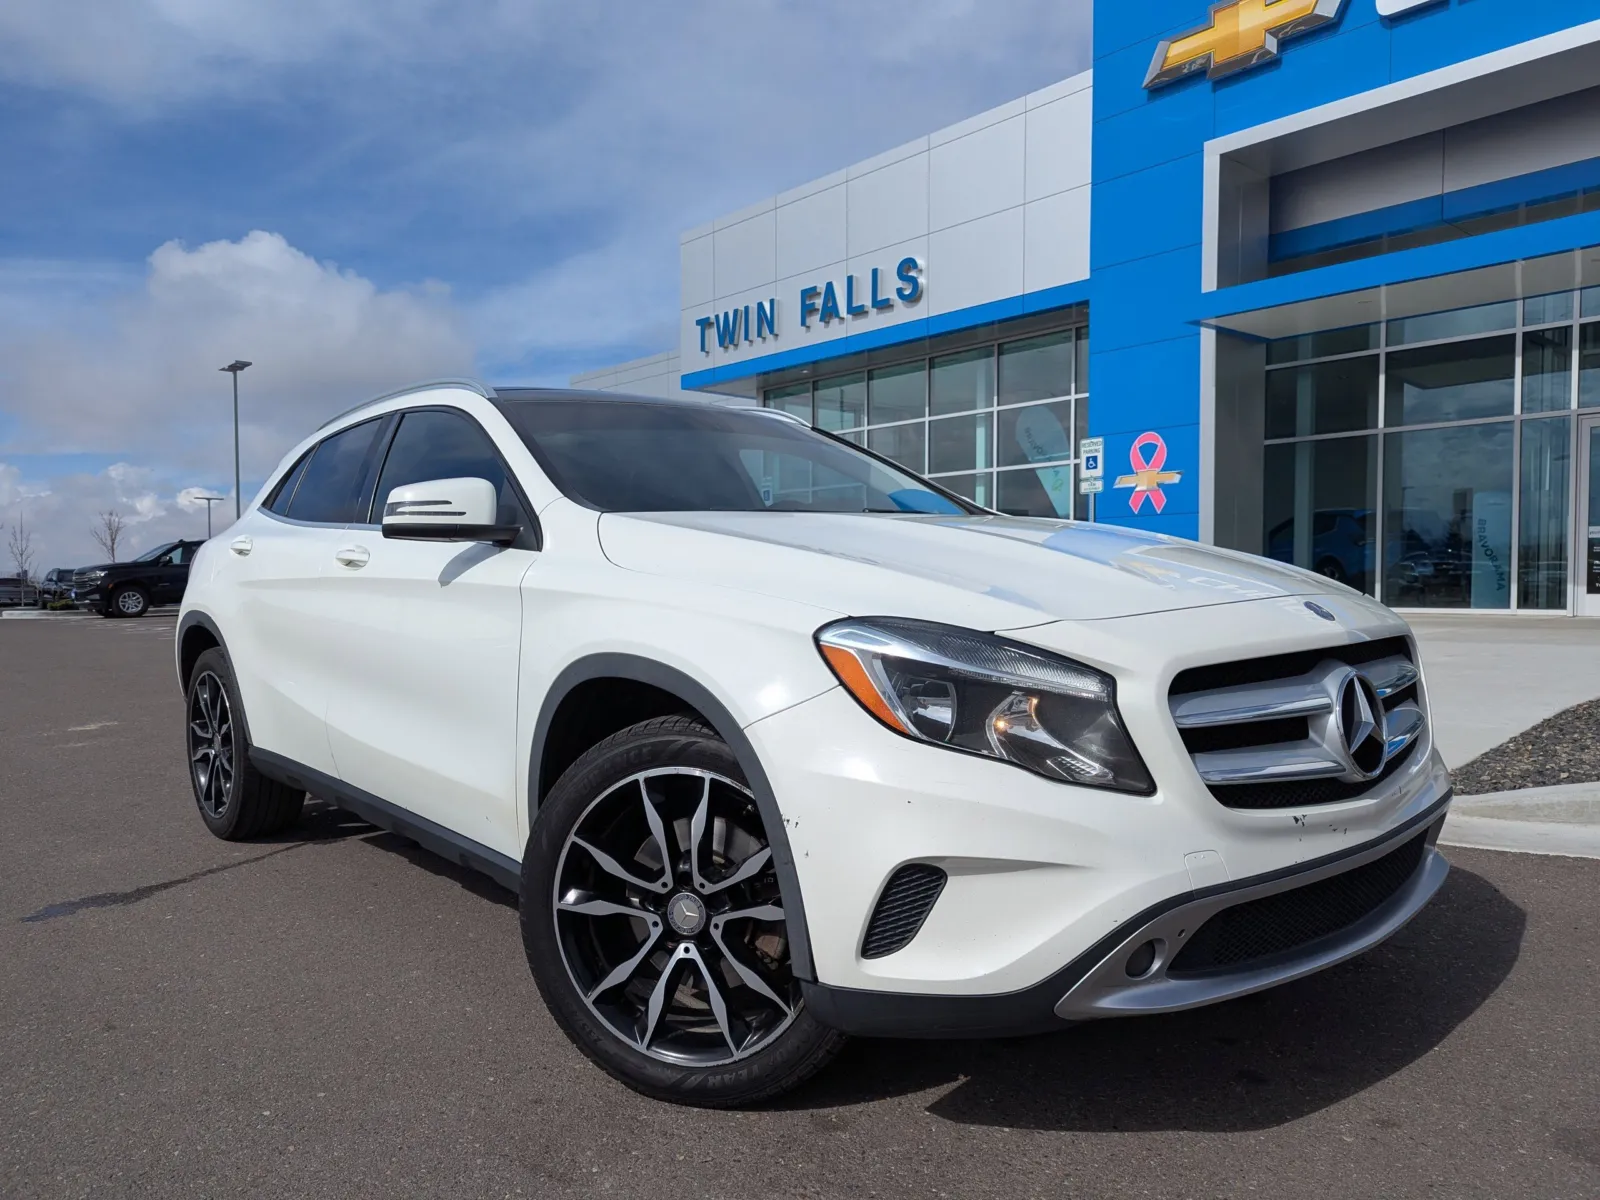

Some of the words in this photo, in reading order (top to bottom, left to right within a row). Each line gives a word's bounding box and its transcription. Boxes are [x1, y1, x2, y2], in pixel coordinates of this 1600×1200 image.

[696, 298, 777, 354] TWIN
[800, 257, 922, 328] FALLS
[1477, 518, 1506, 591] BRAVORAMA
